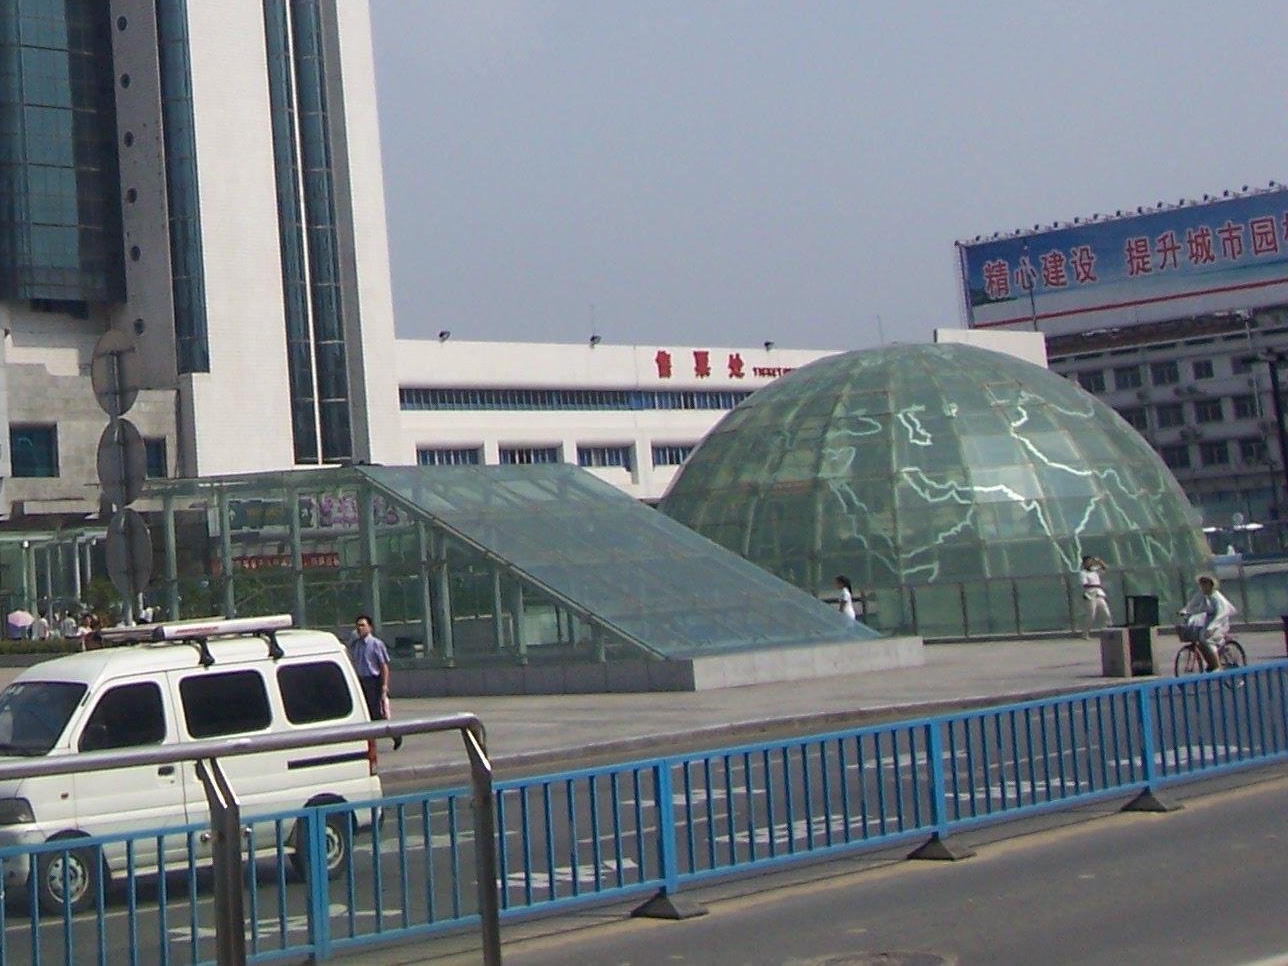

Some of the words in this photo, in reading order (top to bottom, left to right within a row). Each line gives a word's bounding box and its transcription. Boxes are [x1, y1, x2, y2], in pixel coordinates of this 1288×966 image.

[983, 245, 1099, 300] 精心建设
[1123, 212, 1288, 277] 提升城市园
